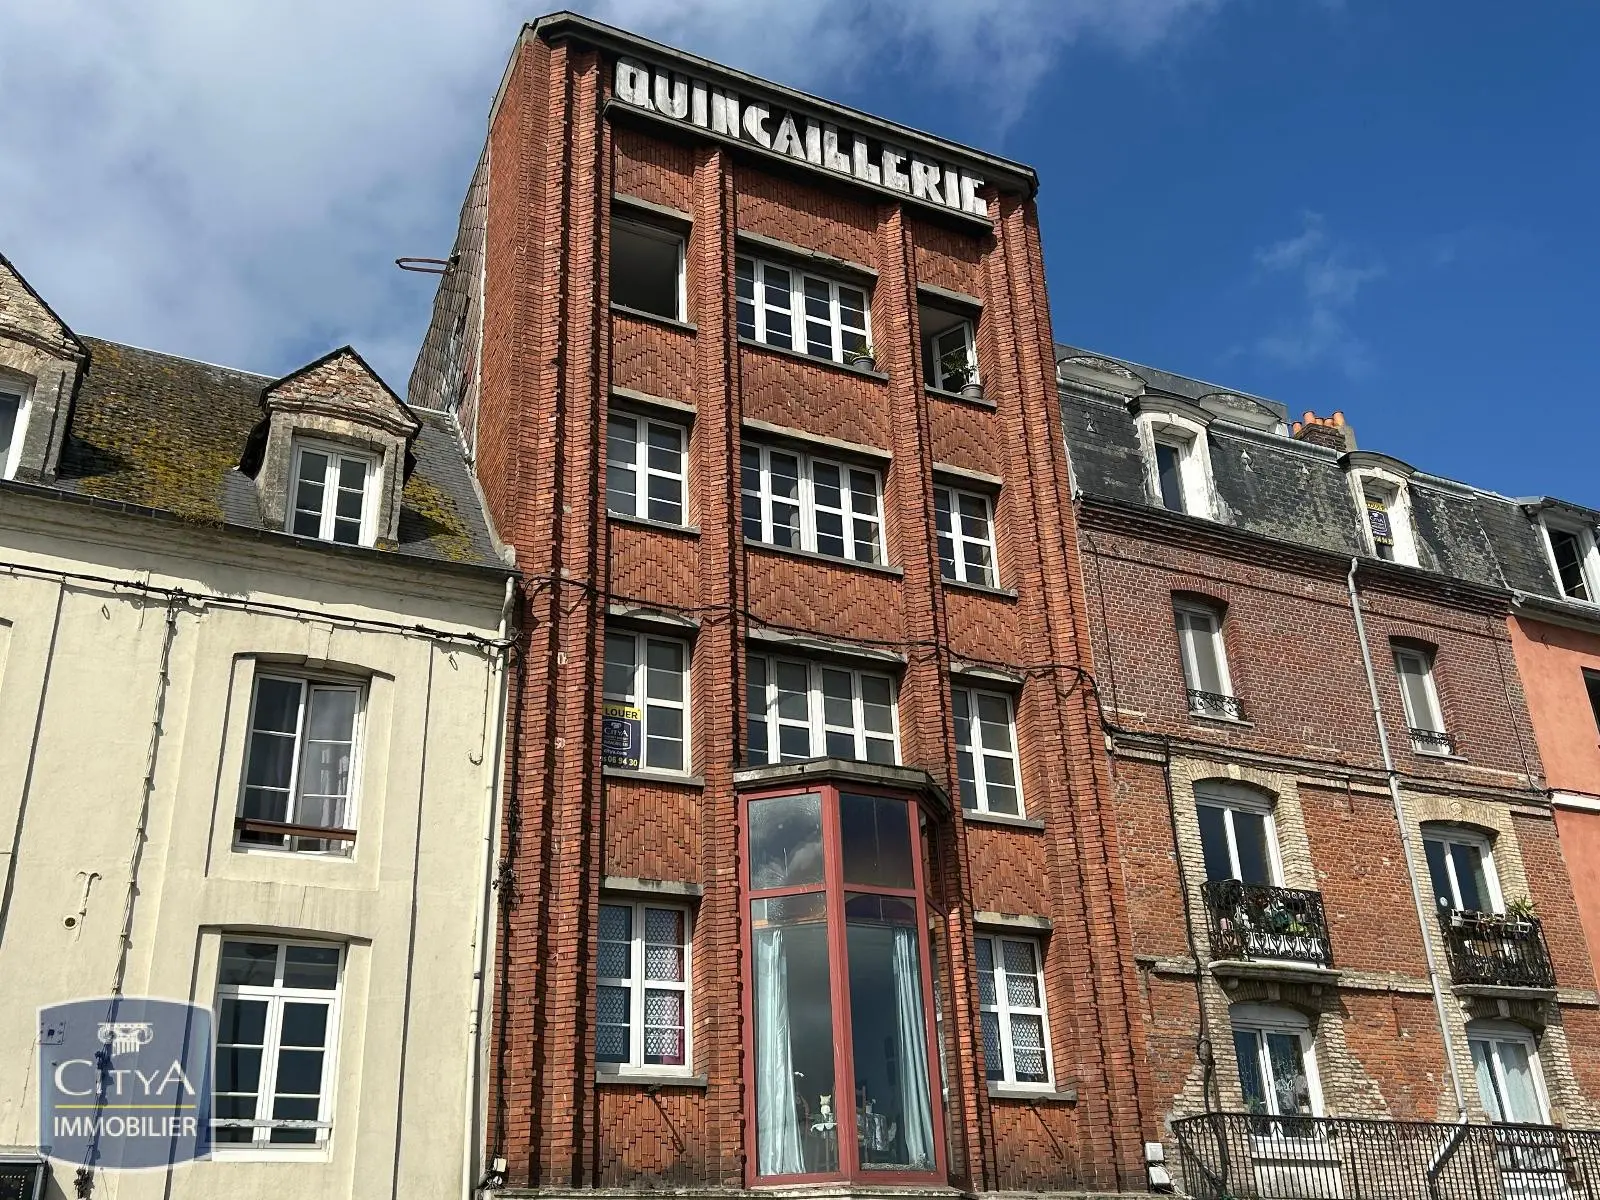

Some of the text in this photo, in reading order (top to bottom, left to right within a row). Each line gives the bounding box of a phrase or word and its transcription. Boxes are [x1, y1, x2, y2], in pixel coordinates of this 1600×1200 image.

[615, 56, 988, 217] QUINCAILLERIE
[605, 708, 638, 719] LOUER
[628, 758, 638, 767] 30
